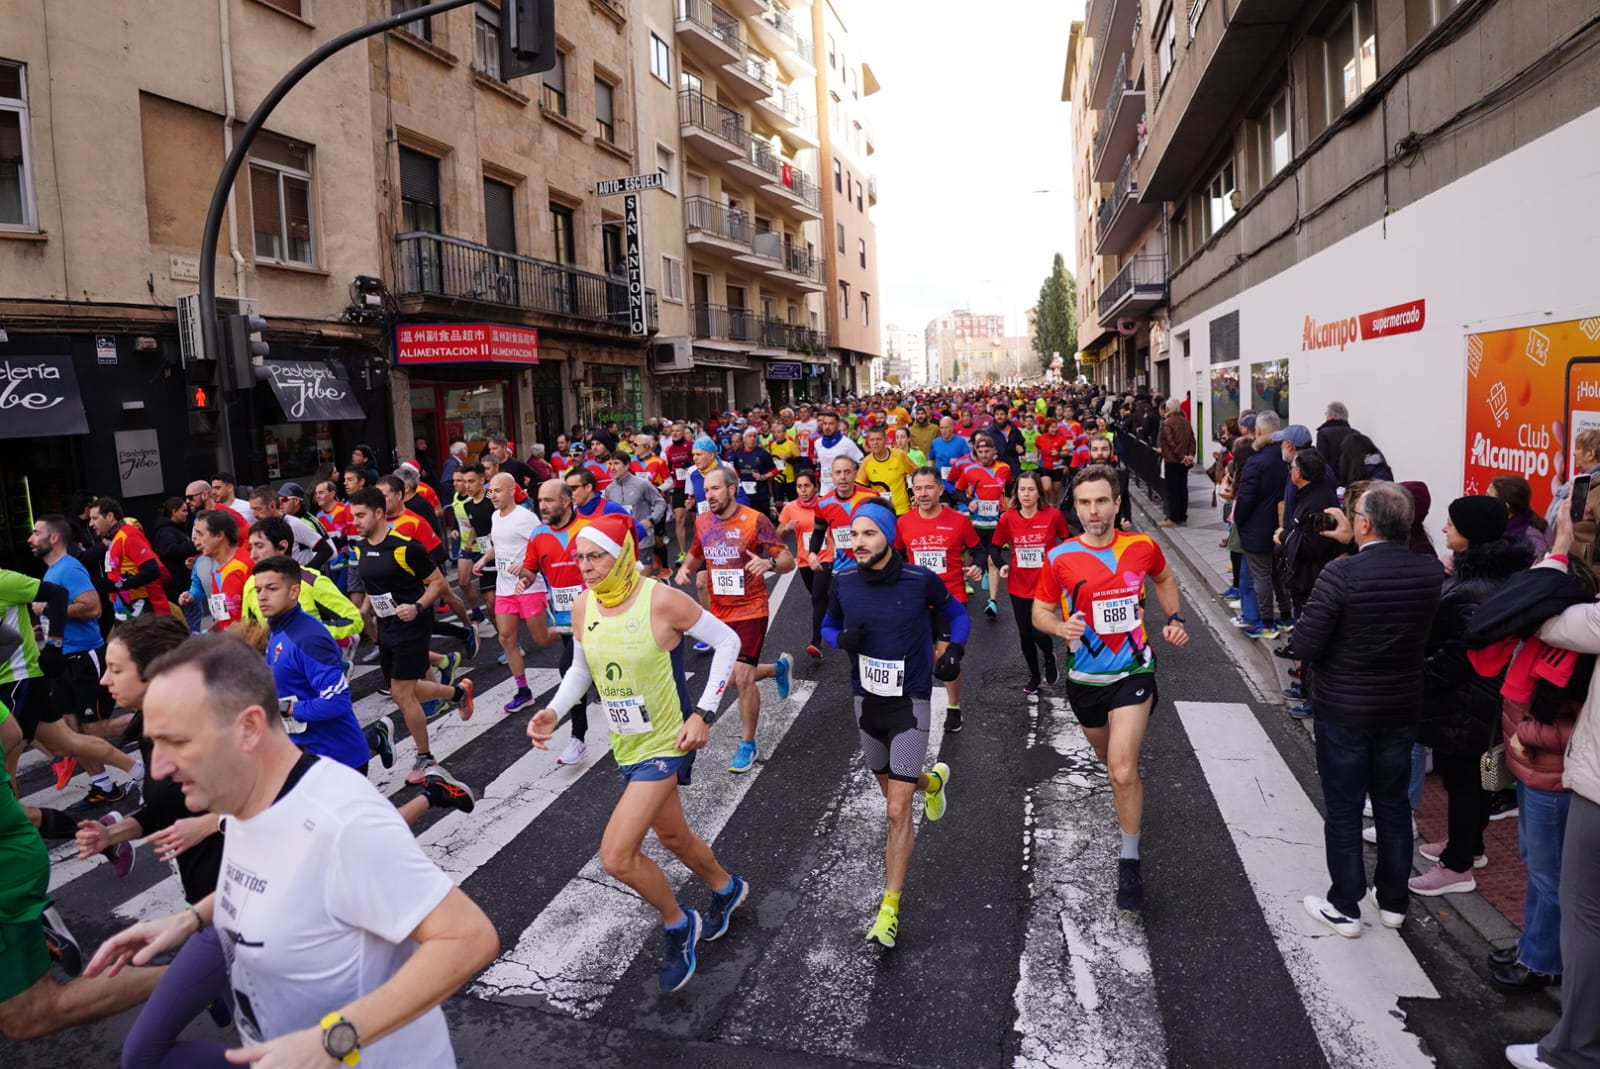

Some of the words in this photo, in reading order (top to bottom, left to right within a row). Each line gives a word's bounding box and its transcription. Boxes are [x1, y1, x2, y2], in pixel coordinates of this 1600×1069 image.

[599, 180, 623, 195] AUTO-
[625, 173, 662, 191] ESCUELA
[627, 197, 637, 236] SAN
[629, 243, 643, 333] ANTONIO
[1302, 314, 1358, 352] Alcampo
[1372, 305, 1420, 334] supermercado
[399, 346, 478, 358] ALIMENTACION
[492, 347, 531, 358] ALIMENTACION
[278, 378, 347, 418] Jibe
[1518, 424, 1550, 449] Club
[1470, 431, 1549, 480] Alcampo
[120, 456, 159, 480] Jibe
[919, 556, 938, 568] 1842
[717, 575, 734, 587] 1315
[1105, 598, 1135, 608] SETEL
[1103, 606, 1127, 623] 688
[868, 659, 900, 670] SETEL
[864, 665, 890, 684] 1408
[606, 699, 640, 708] SETEL
[609, 708, 630, 723] 613
